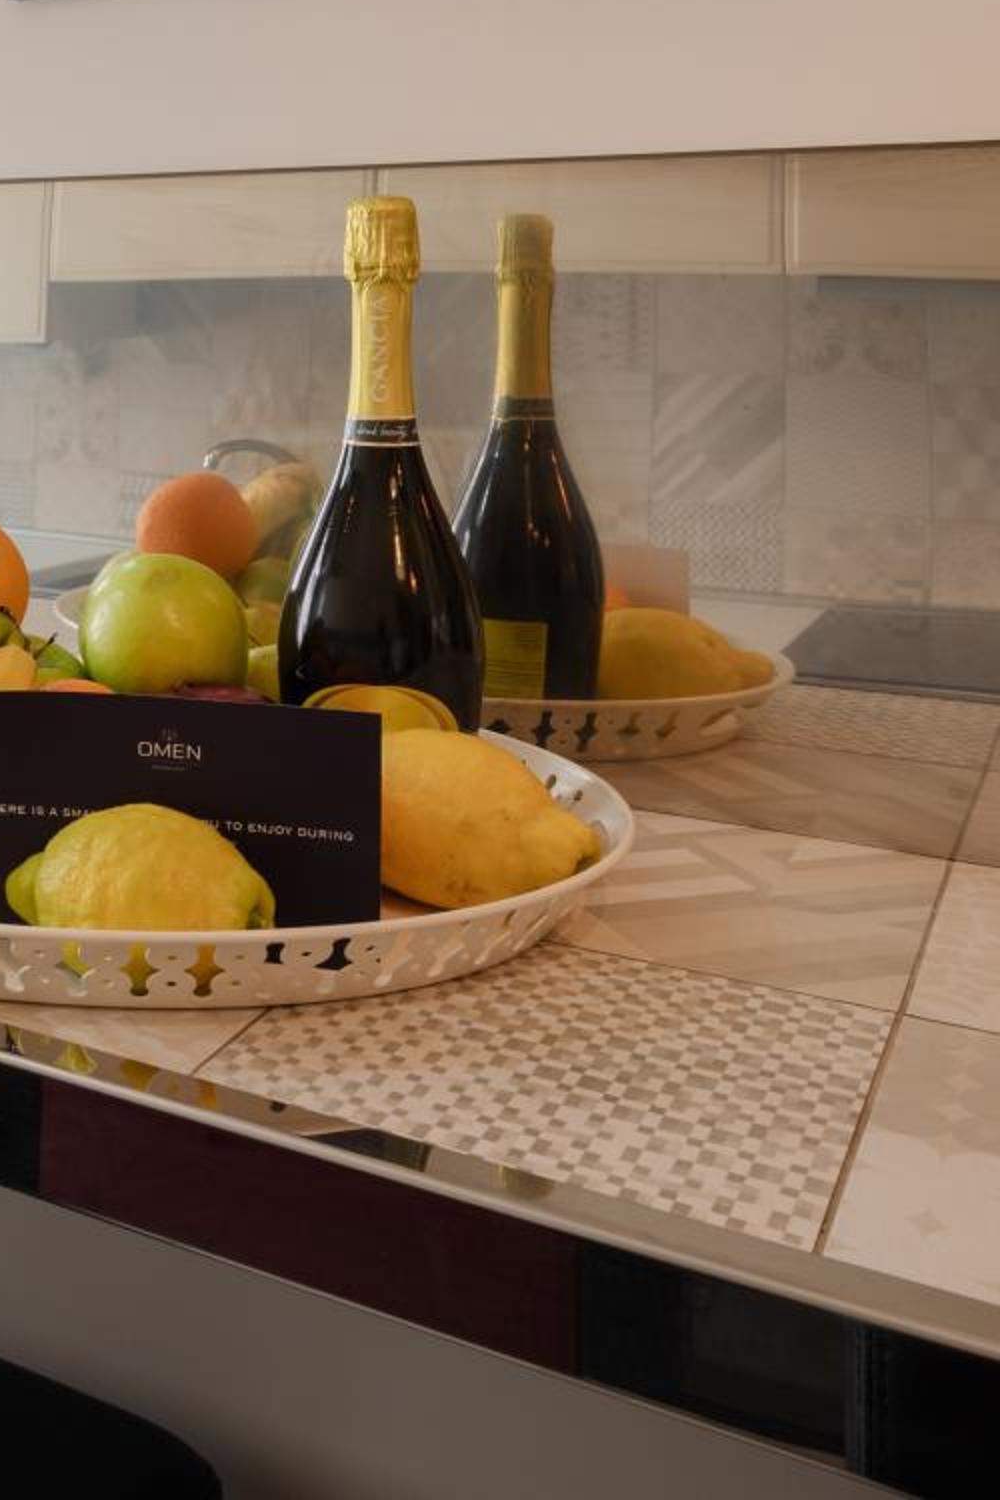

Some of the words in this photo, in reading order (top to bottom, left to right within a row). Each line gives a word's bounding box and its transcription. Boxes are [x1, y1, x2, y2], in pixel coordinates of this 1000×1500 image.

[369, 292, 393, 404] GANCIA
[137, 741, 201, 761] OMEN
[31, 805, 45, 816] IS
[49, 806, 59, 816] A
[226, 820, 243, 832] TO
[248, 822, 293, 835] ENJOY
[298, 827, 354, 841] DURING
